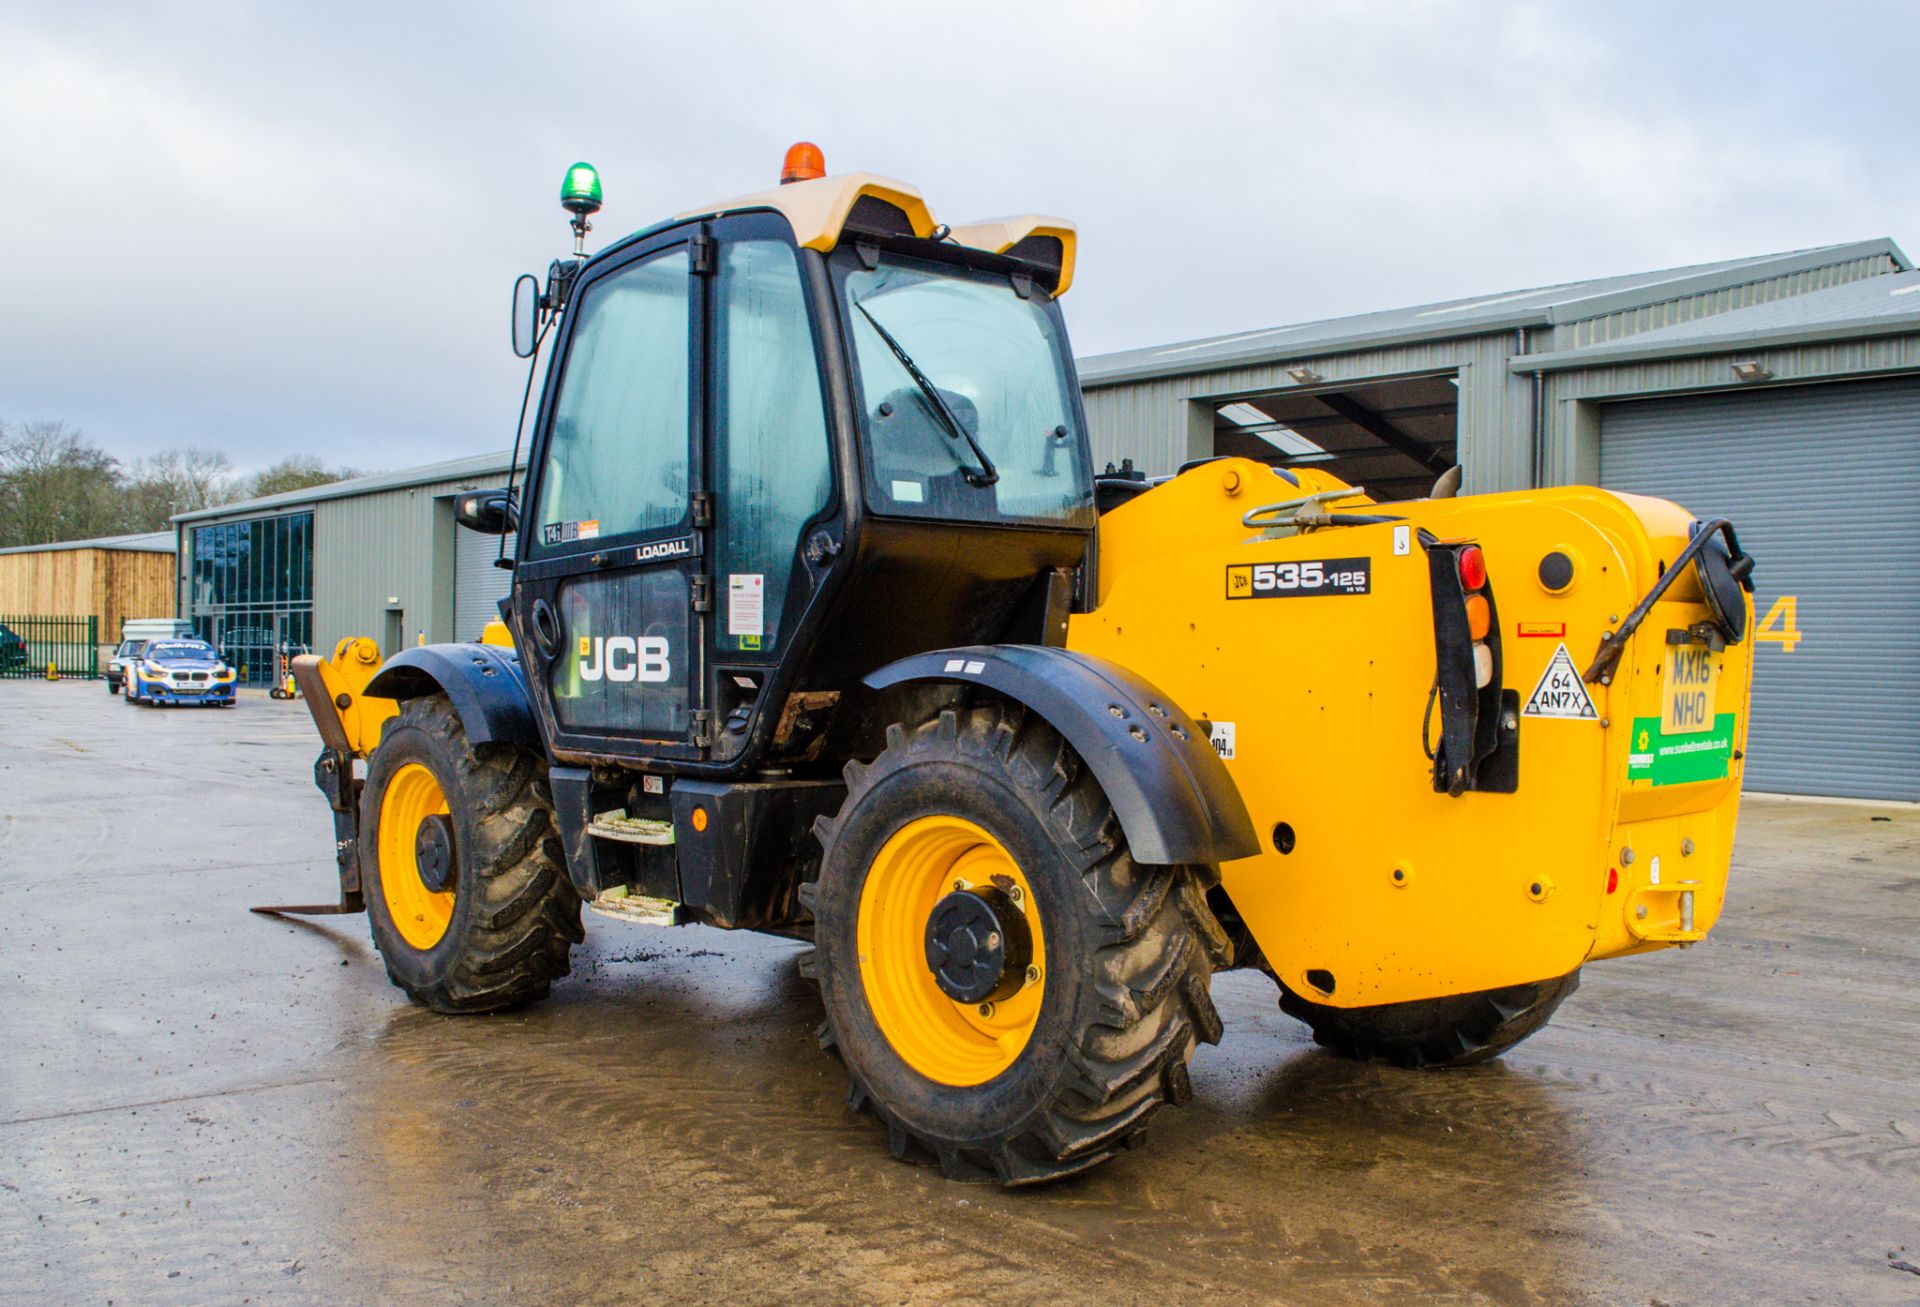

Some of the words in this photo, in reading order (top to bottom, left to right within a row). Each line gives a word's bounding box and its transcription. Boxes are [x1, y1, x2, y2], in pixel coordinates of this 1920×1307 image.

[637, 540, 689, 560] LOADALL
[1234, 574, 1248, 589] JCB
[1756, 596, 1802, 653] 4
[579, 636, 670, 682] JCB
[1673, 650, 1711, 685] MX16
[1551, 673, 1570, 689] 64
[1541, 691, 1581, 709] AN7X
